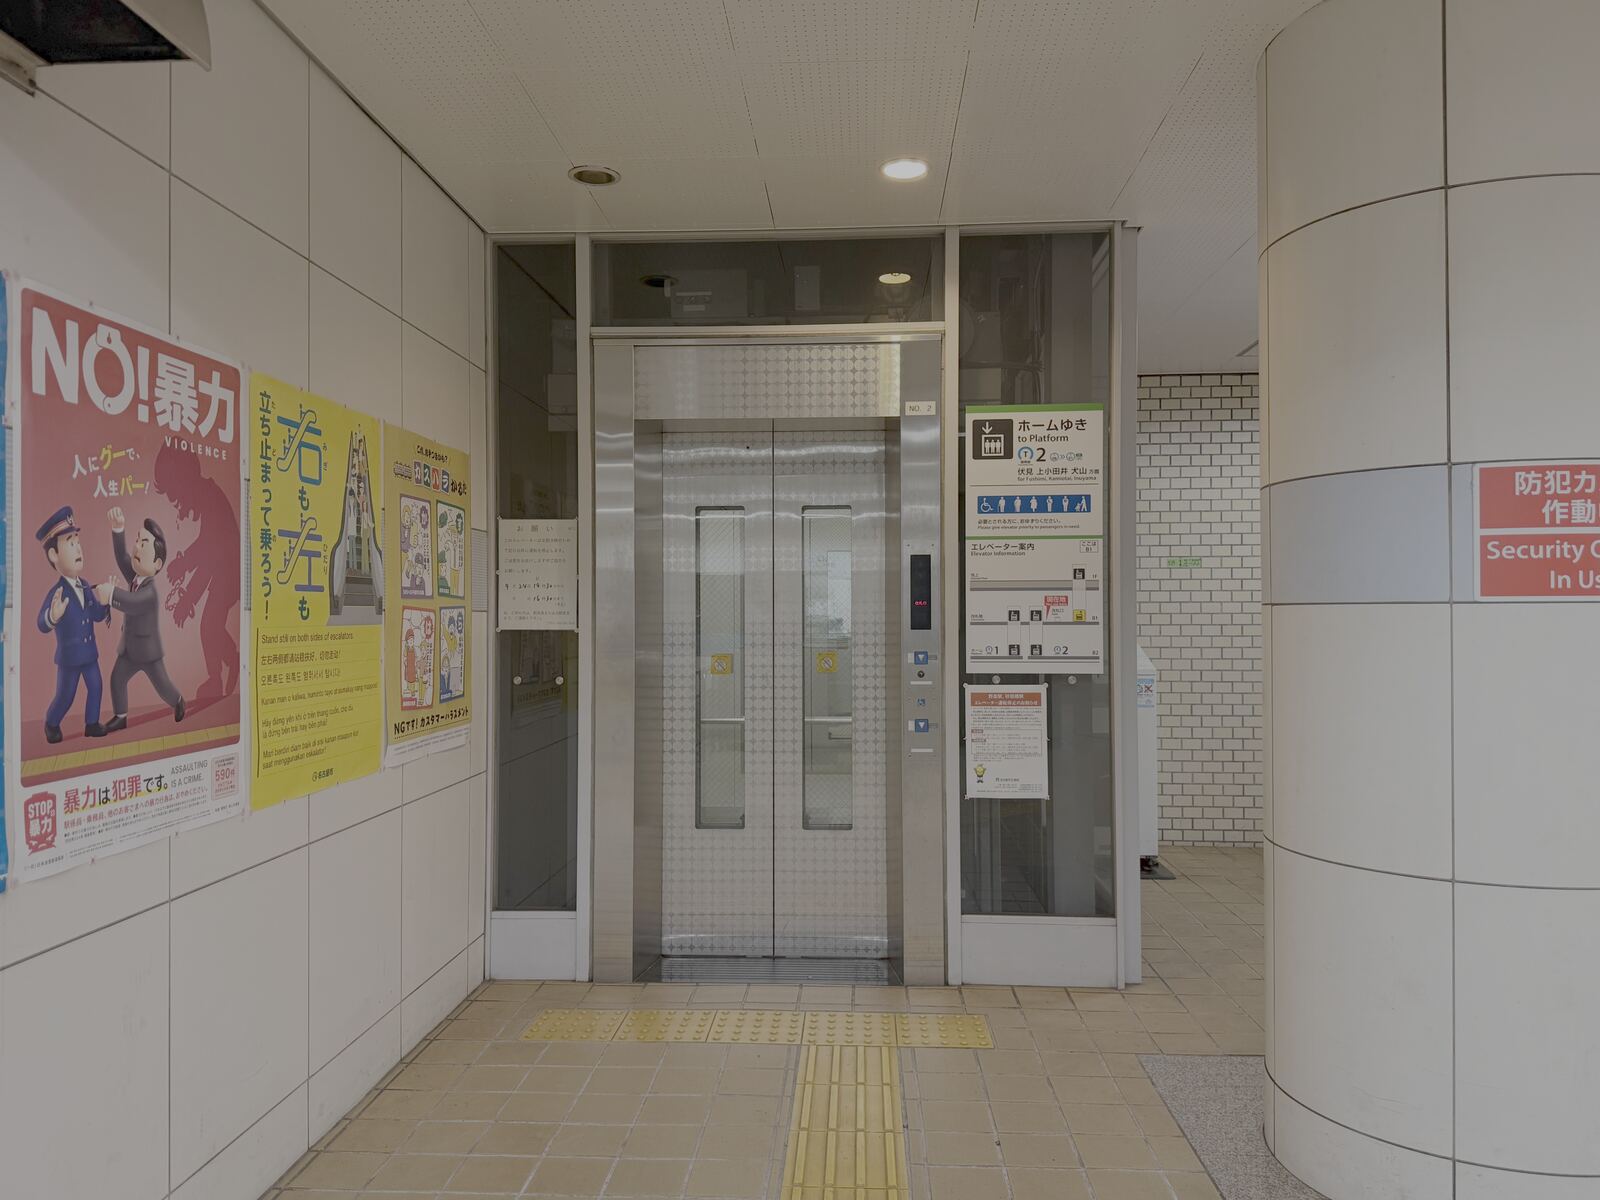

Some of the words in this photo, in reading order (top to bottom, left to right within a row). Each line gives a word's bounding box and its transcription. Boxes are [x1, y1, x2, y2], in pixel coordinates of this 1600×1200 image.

[1018, 418, 1087, 432] ホームゆき
[1017, 435, 1027, 443] to
[1029, 434, 1069, 442] Platform
[164, 435, 228, 460] VIOLENCE
[1036, 447, 1046, 462] 2
[1018, 468, 1033, 476] 伏見
[1036, 467, 1069, 476] 上小田井
[1071, 467, 1087, 475] 犬山
[971, 543, 1035, 551] エレベーター案内
[1487, 540, 1584, 564] Security
[1549, 570, 1572, 589] In
[262, 634, 279, 644] Stand
[297, 633, 310, 642] both
[171, 759, 208, 775] ASSAULTING
[183, 773, 204, 785] CRIME.
[64, 773, 168, 814] 暴力は犯罪です。
[28, 799, 53, 819] STOP
